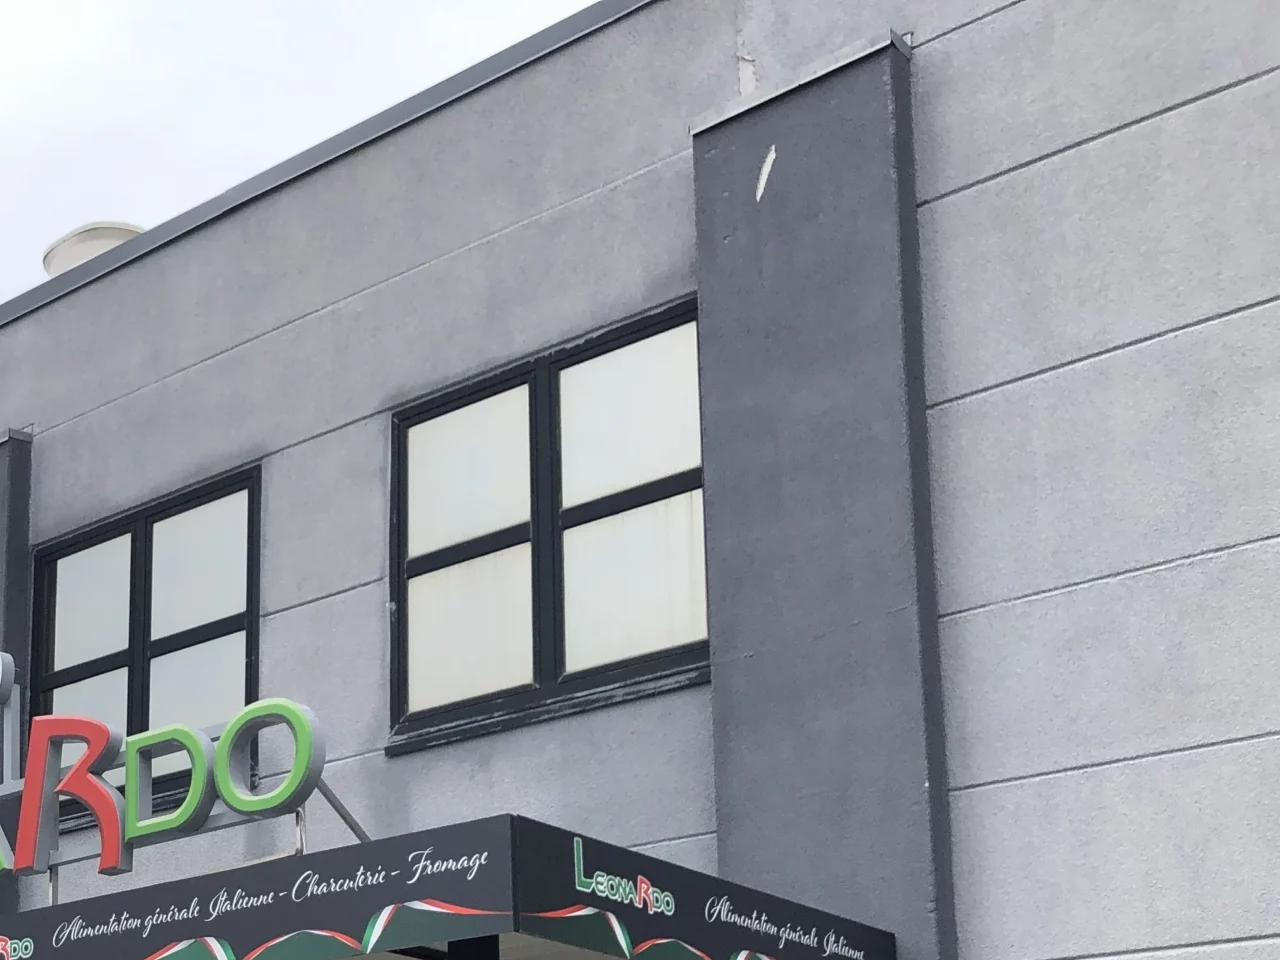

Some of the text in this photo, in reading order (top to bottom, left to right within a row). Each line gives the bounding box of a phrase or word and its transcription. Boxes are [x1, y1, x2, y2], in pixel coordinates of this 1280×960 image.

[52, 915, 142, 948] Alimentation
[142, 897, 200, 938] générale
[204, 886, 274, 921] Italienne
[291, 864, 386, 902] Charcuterie
[406, 846, 488, 884] Fromage
[704, 895, 778, 935] Alimentation
[778, 923, 819, 949] générale
